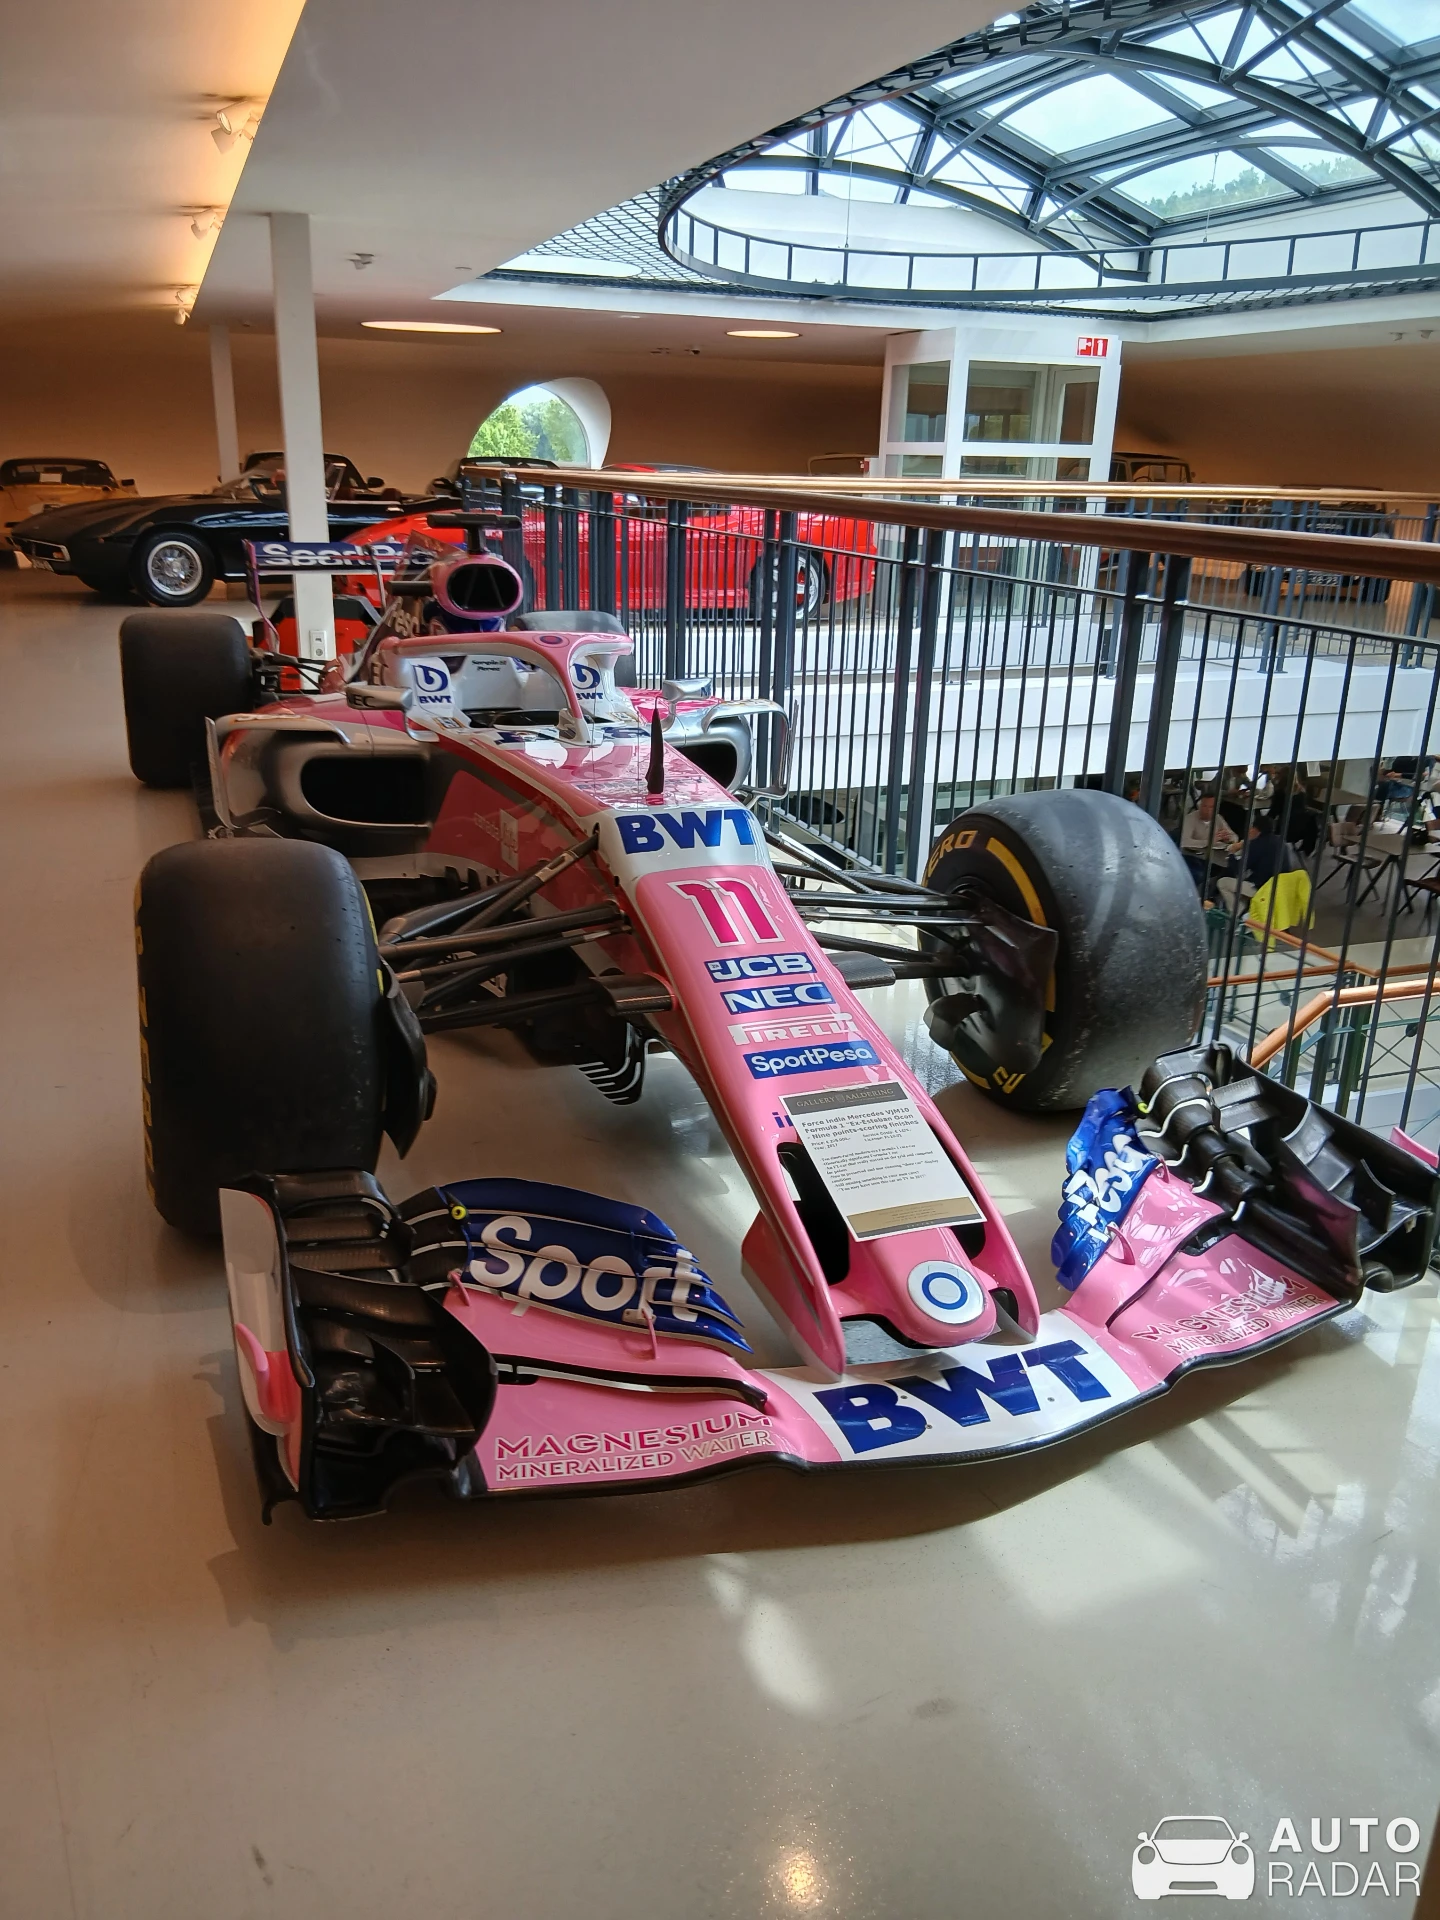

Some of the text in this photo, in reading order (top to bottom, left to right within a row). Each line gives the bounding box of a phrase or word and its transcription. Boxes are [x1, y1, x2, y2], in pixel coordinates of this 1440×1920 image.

[418, 695, 452, 704] BWT
[614, 808, 756, 854] BWT
[667, 877, 784, 948] 11
[708, 954, 813, 981] JCB
[723, 983, 833, 1013] NEC
[727, 1012, 860, 1046] PIRELLI
[751, 1047, 873, 1075] SportPesa
[796, 1096, 835, 1107] GALLERY
[845, 1089, 895, 1100] AALDERING
[846, 1110, 884, 1120] Mercedes
[884, 1107, 910, 1115] VJM10
[804, 1124, 838, 1133] Formula
[831, 1123, 888, 1136] points-scoring
[888, 1119, 919, 1127] finishes
[469, 1215, 702, 1323] Sport
[1131, 1275, 1308, 1341] MAGNESIUM
[1164, 1293, 1328, 1355] MINERALIZED WATER
[812, 1339, 1111, 1454] BWT
[495, 1411, 773, 1461] MAGNESIUM
[496, 1428, 775, 1481] MINERALIZED WATER
